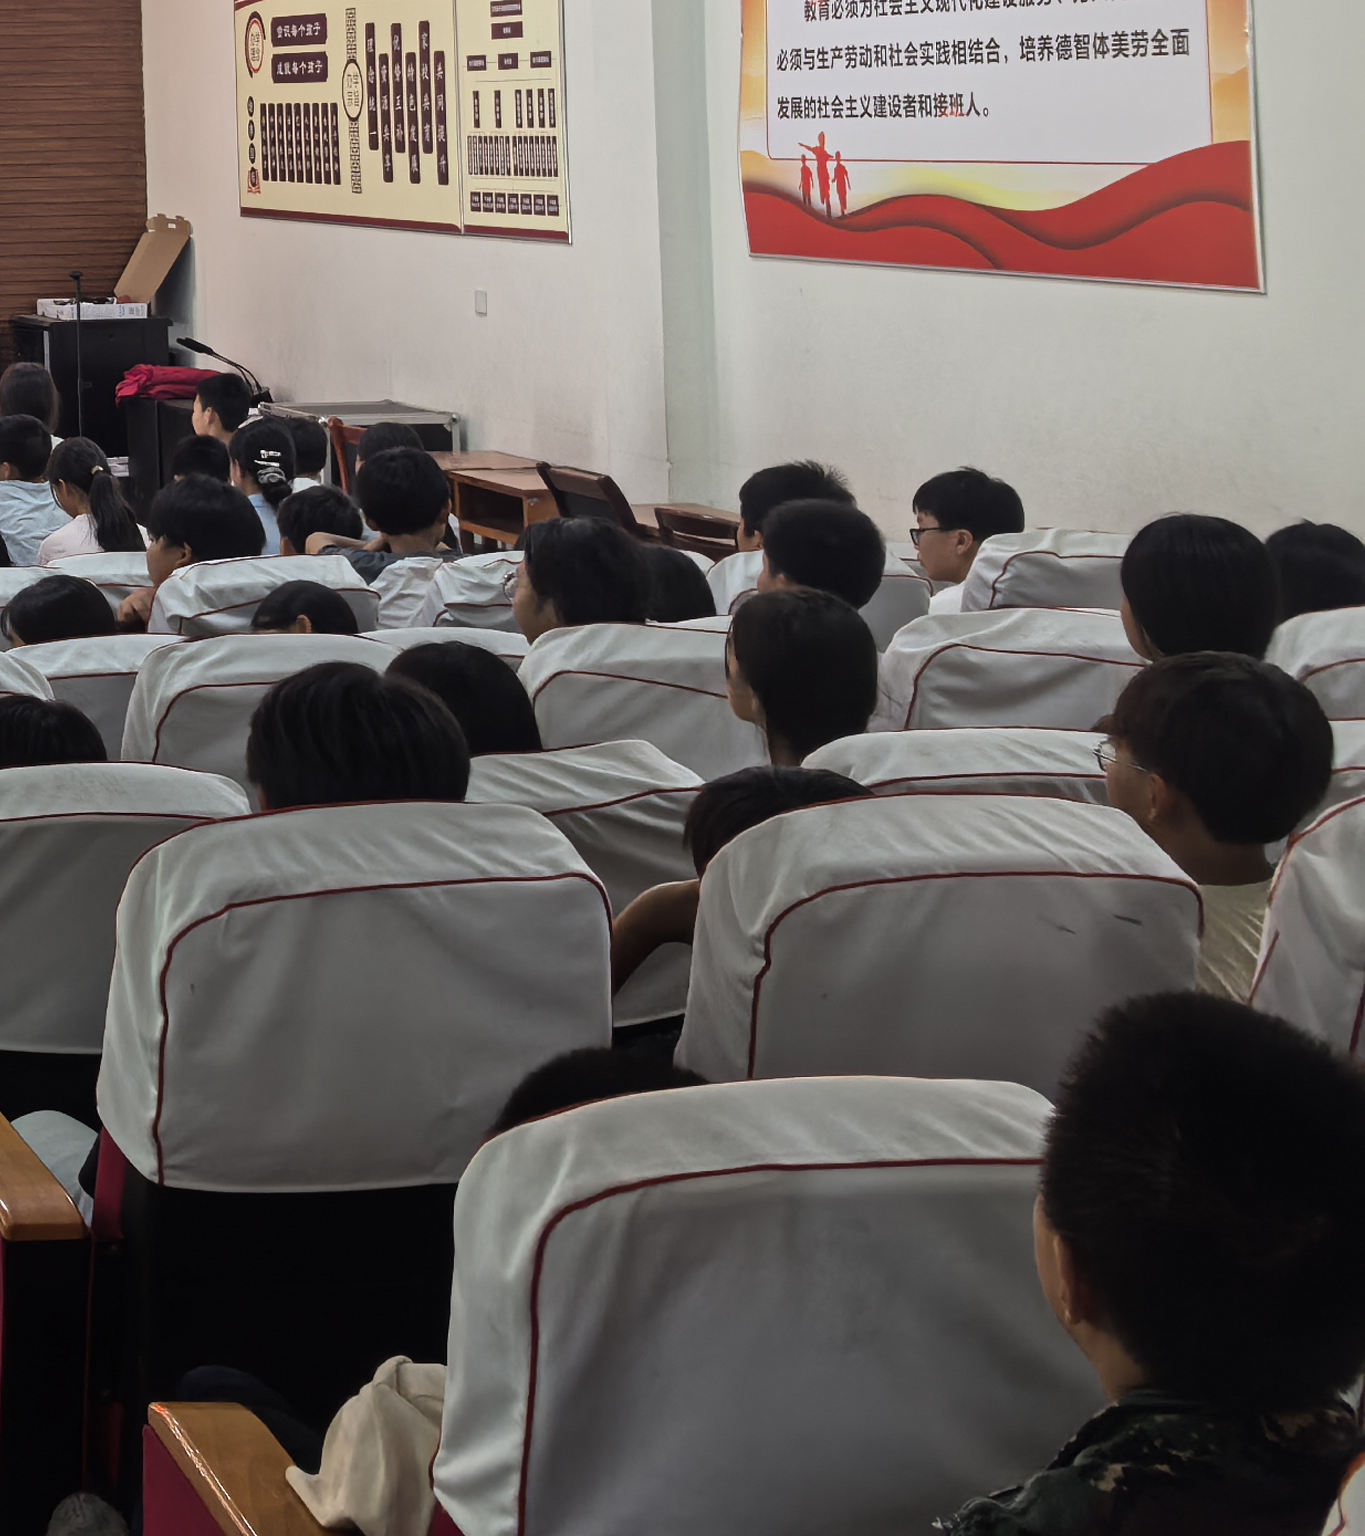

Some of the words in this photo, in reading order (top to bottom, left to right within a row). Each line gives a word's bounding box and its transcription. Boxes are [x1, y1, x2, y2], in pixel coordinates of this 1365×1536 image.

[776, 27, 1190, 72] 必须与生产劳动和社会实践相结合，培养德智体美劳全面
[776, 91, 990, 120] 发展的社会主义建设者和接班人。
